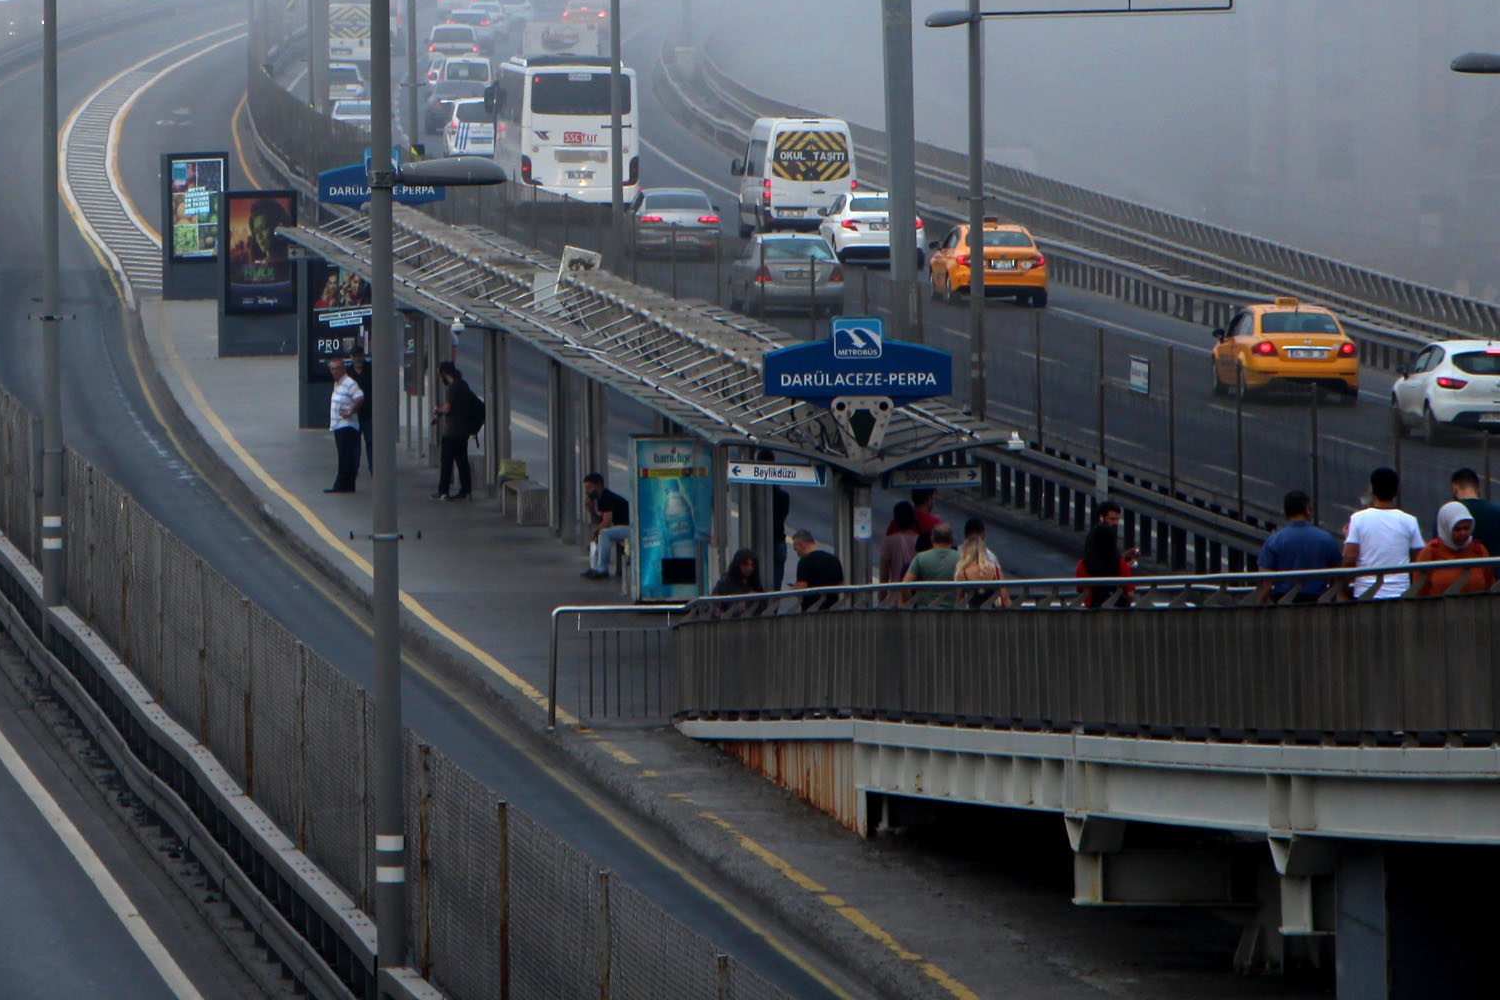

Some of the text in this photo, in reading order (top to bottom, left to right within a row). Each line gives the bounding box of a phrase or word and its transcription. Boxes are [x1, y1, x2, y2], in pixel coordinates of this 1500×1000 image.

[780, 151, 806, 160] OKUL
[329, 185, 435, 196] DARÜLAE-PERPA
[318, 339, 340, 351] PRO
[837, 347, 878, 356] METROBÜS
[780, 370, 937, 387] DARÜLACEZE-PERPA
[753, 466, 797, 480] Beylikdüzü
